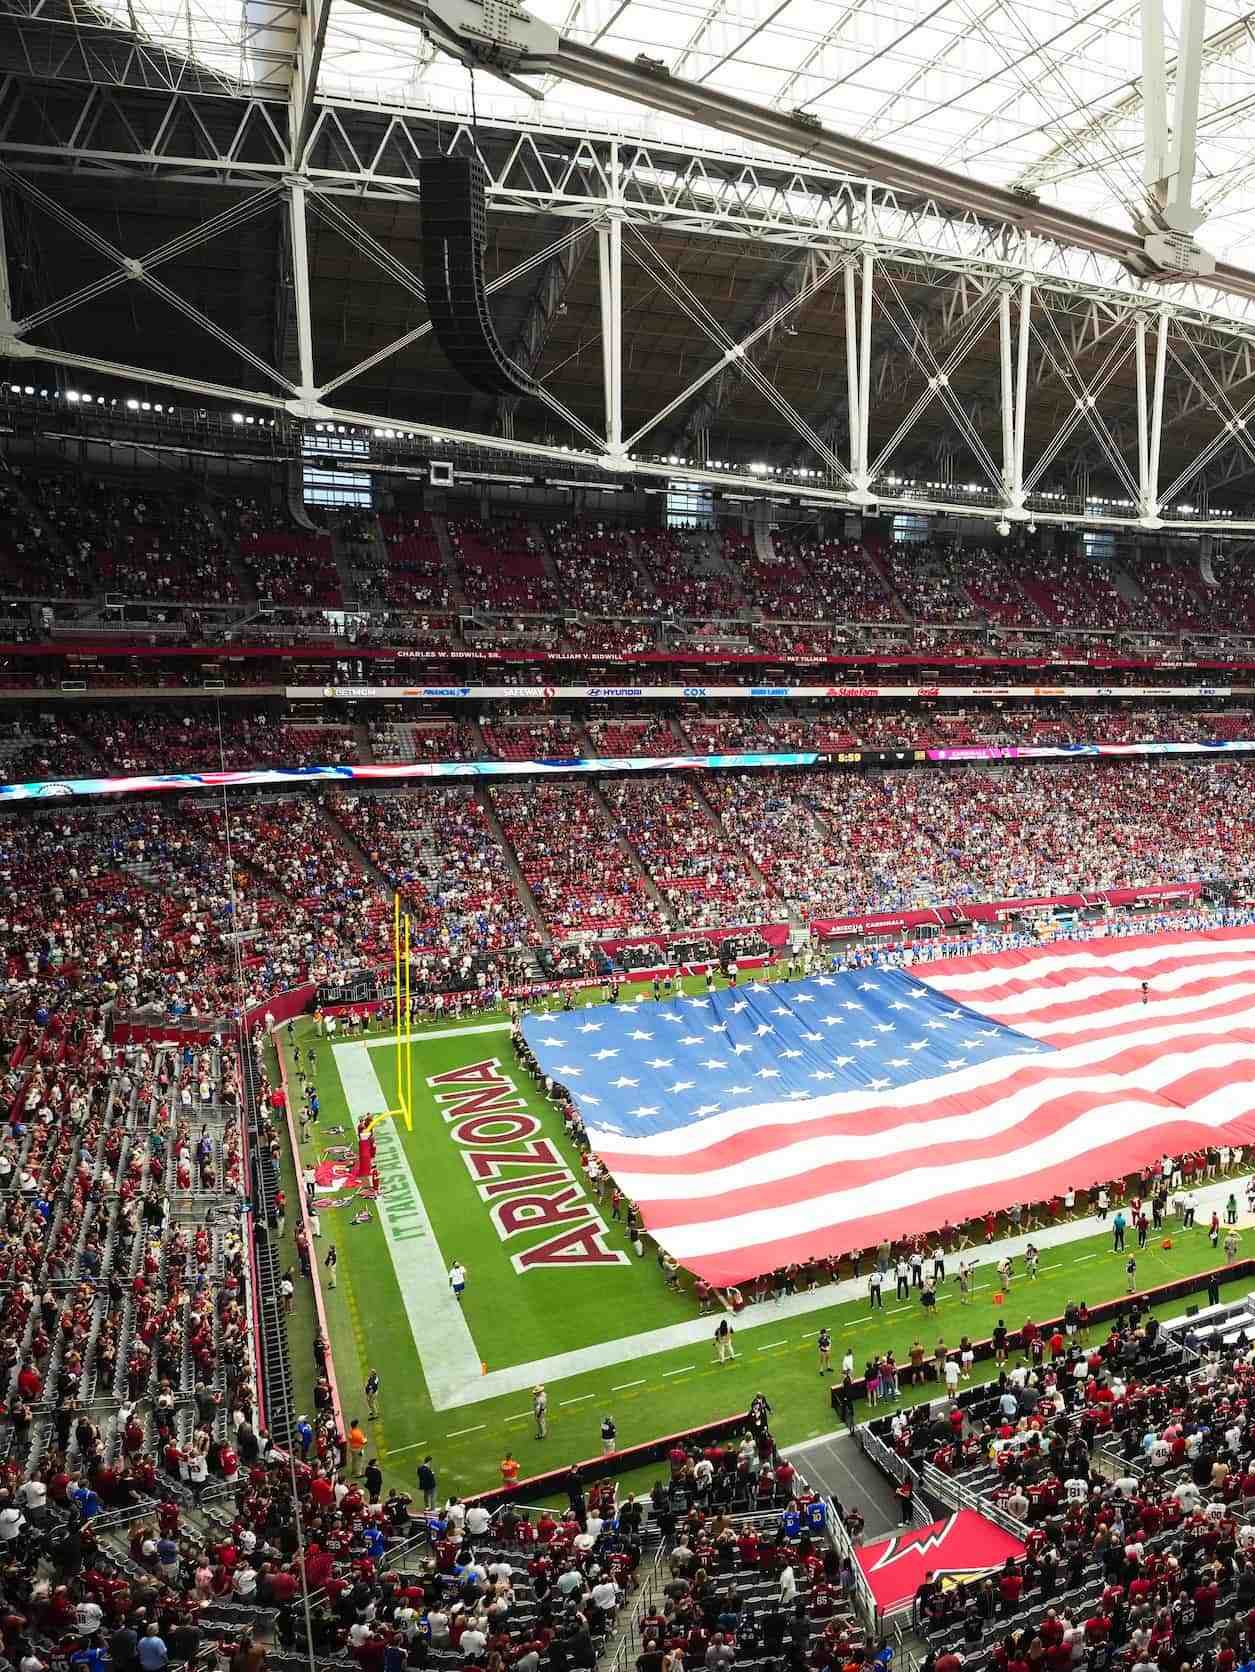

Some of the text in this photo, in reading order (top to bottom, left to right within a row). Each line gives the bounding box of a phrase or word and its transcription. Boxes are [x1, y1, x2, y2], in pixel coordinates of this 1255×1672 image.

[504, 688, 544, 697] SAFEWAY
[684, 688, 706, 696] COX
[426, 1058, 632, 1275] ARIZONA
